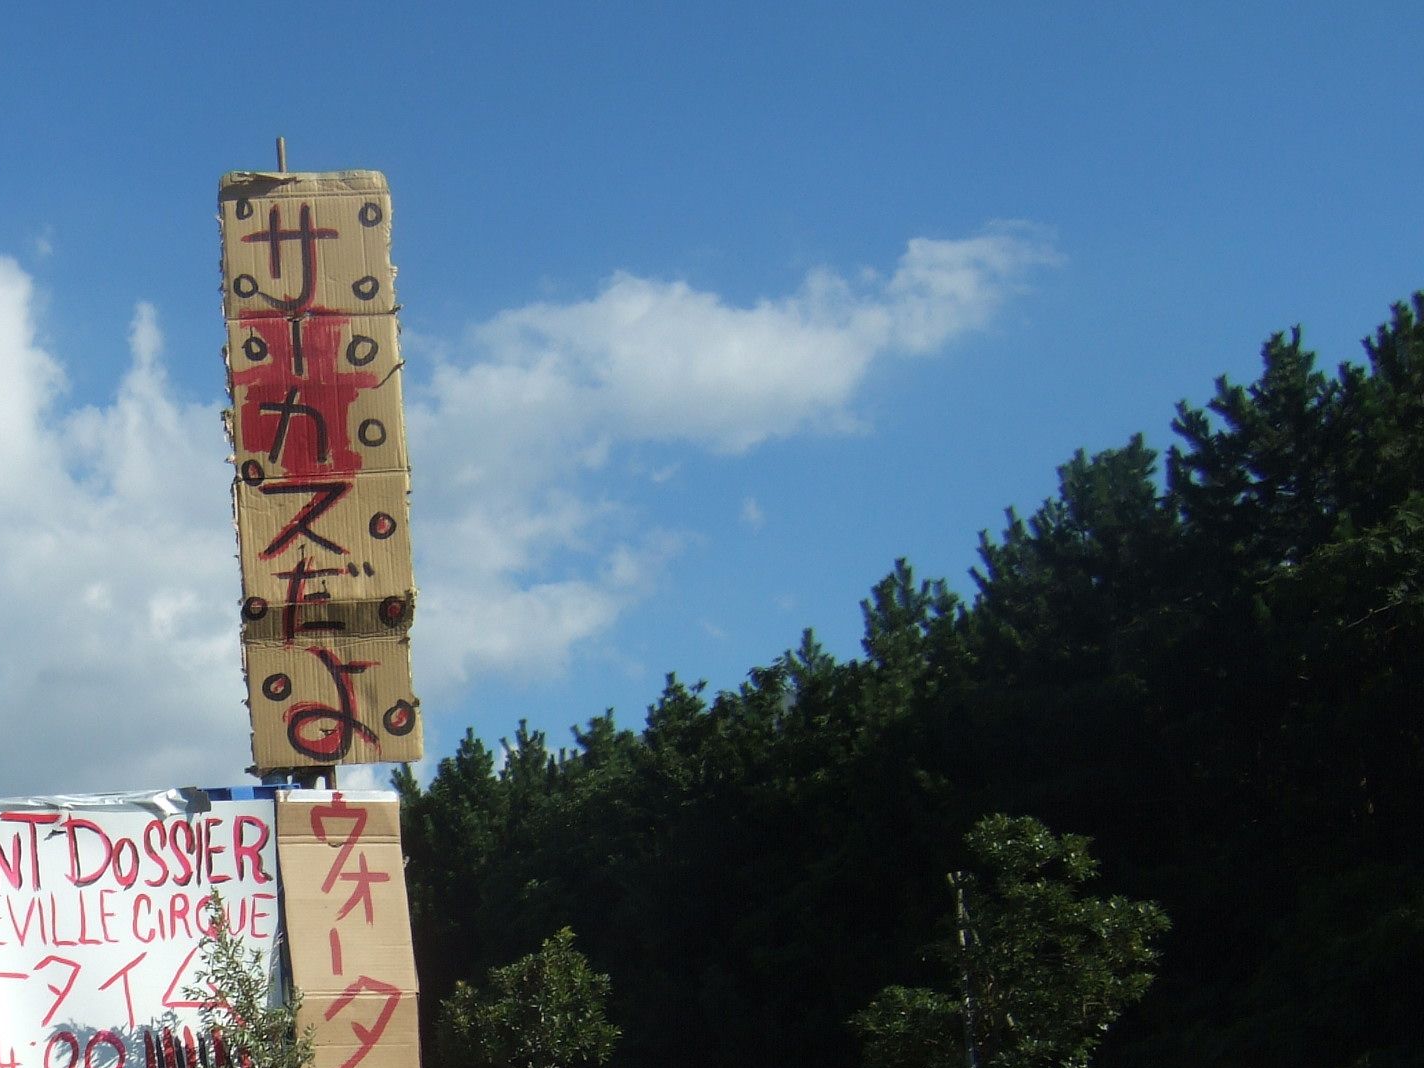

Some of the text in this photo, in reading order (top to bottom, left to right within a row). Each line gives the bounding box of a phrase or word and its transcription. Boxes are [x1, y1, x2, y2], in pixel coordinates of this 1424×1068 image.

[240, 202, 382, 762] サーカスだよ
[60, 813, 274, 890] DOSSIER
